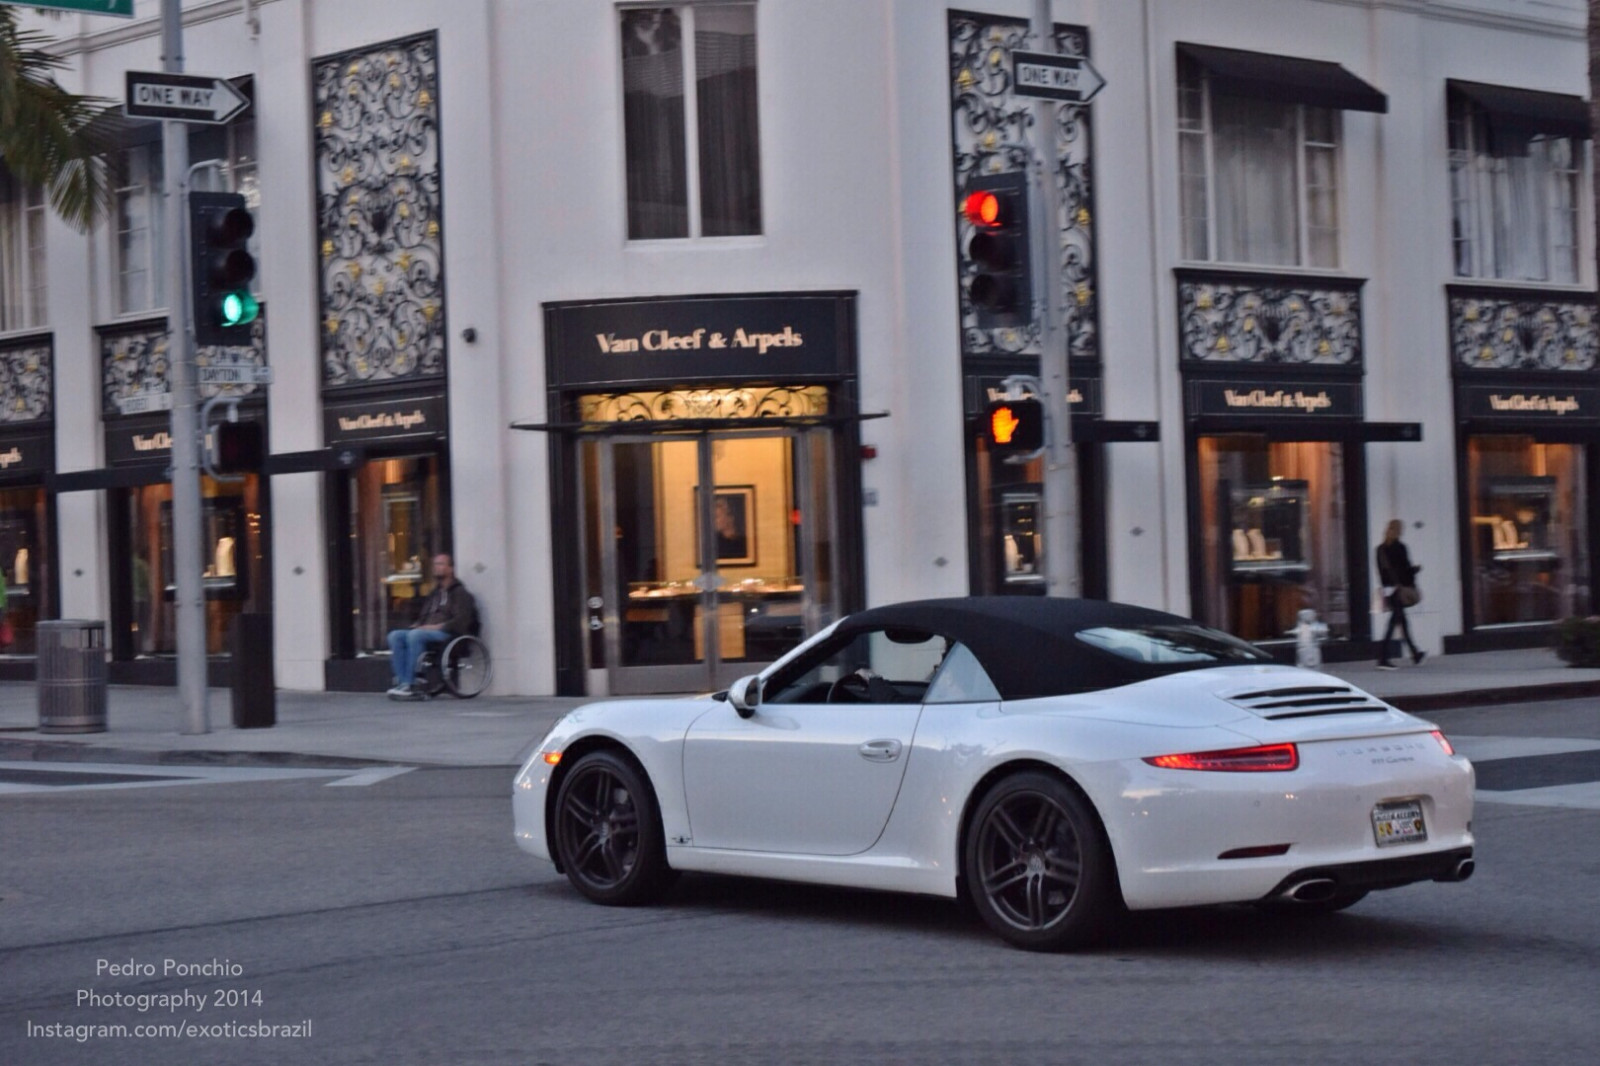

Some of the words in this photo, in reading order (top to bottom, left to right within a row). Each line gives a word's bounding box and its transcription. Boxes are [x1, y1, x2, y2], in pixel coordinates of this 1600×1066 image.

[1023, 66, 1048, 84] ONE
[1053, 71, 1079, 88] WAY
[140, 86, 174, 104] ONE
[180, 89, 213, 107] WAY
[596, 333, 639, 353] Van
[642, 328, 706, 351] Cleef
[708, 332, 727, 349] &
[730, 326, 803, 354] Arpels
